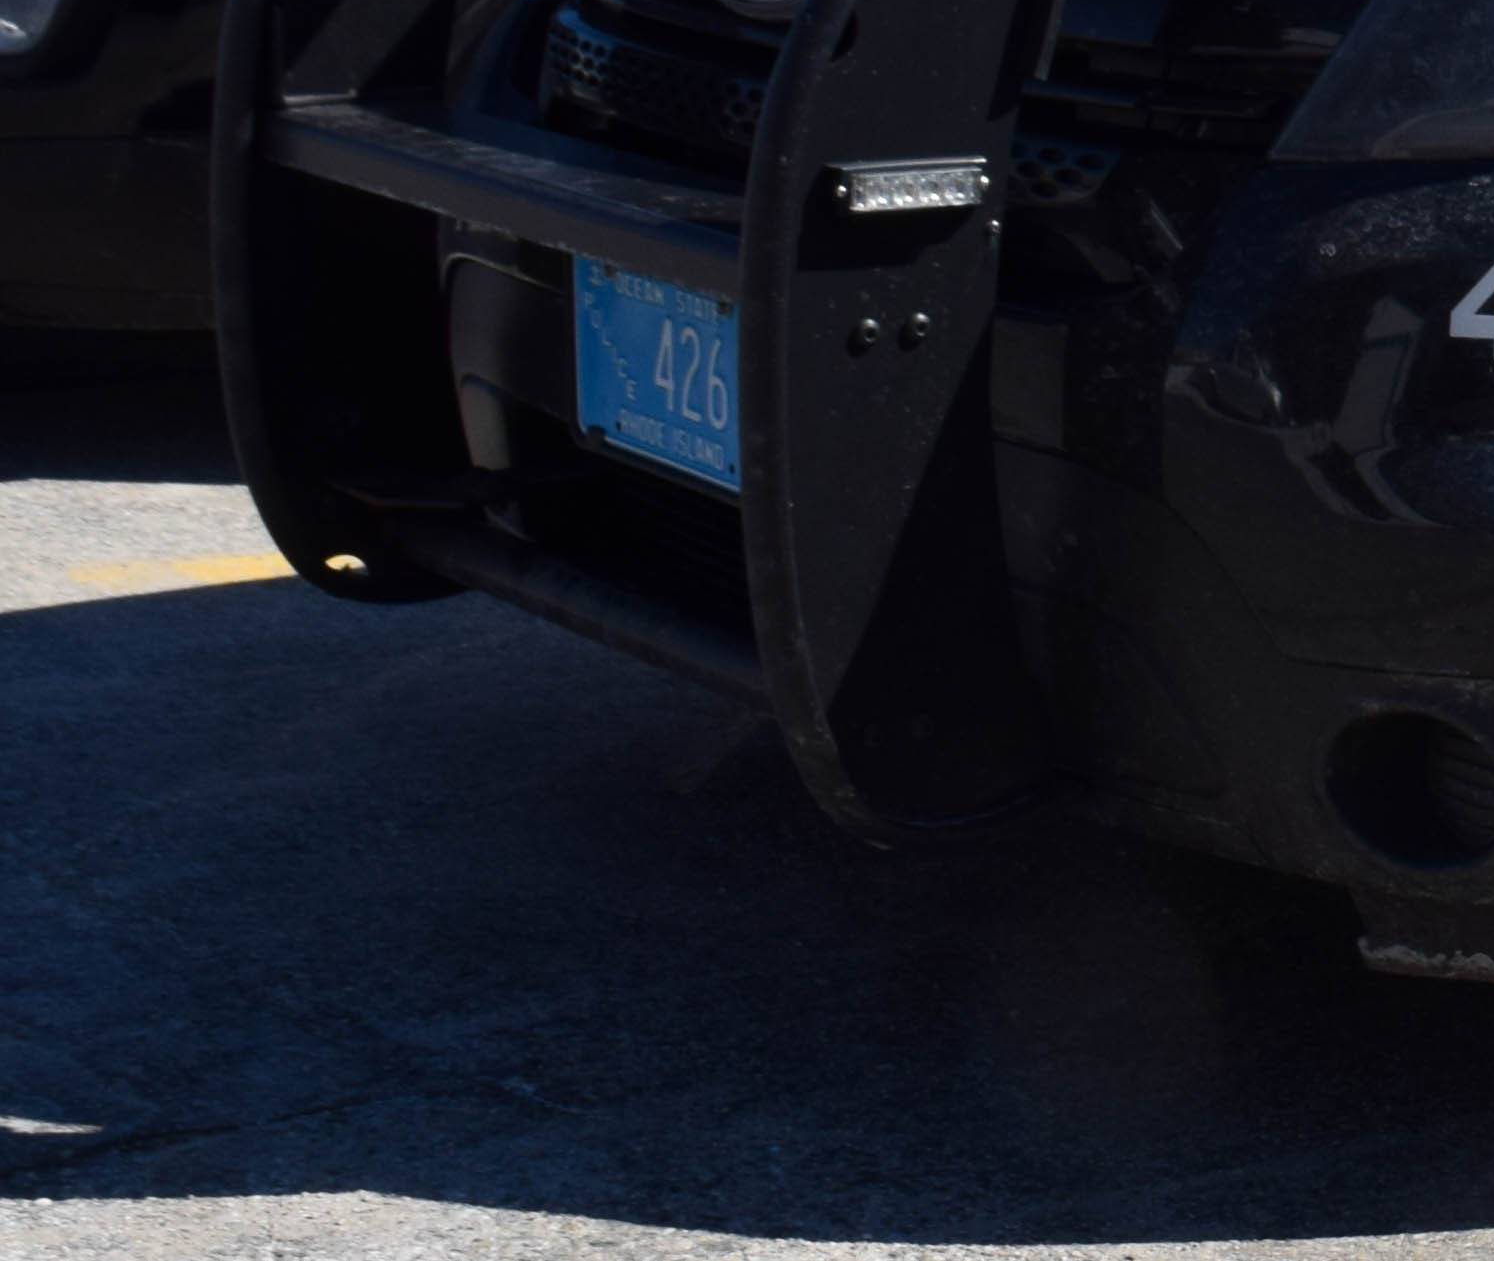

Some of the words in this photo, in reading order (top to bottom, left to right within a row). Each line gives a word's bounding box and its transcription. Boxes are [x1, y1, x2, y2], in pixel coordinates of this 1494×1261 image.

[615, 271, 665, 308] OCEAN
[675, 289, 720, 327] STATE
[653, 317, 730, 432] 426
[617, 407, 666, 449] RHODE
[671, 427, 726, 472] ISLAND
